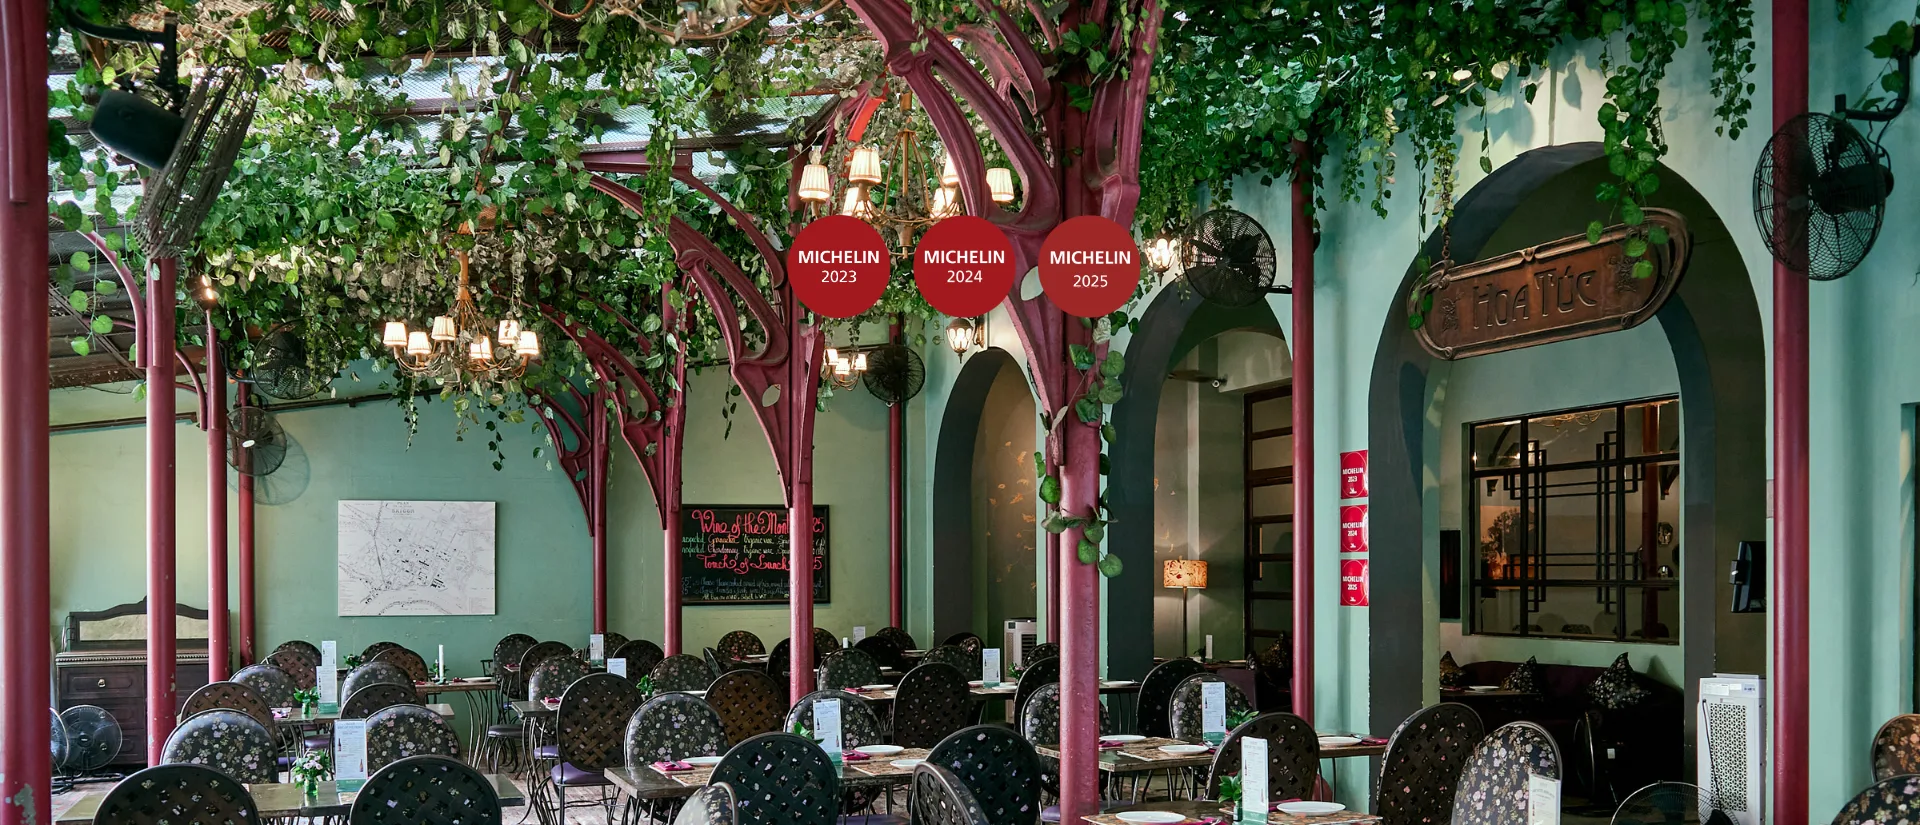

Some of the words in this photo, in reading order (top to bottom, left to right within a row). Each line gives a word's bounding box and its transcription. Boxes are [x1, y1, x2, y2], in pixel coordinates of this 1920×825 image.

[1342, 467, 1364, 475] MICHELIN
[691, 509, 731, 534] Wine
[731, 514, 741, 538] of
[742, 512, 762, 534] the
[758, 510, 790, 534] Mont
[1342, 521, 1364, 529] MICHELIN
[734, 557, 749, 575] of
[1342, 575, 1364, 583] MICHELIN
